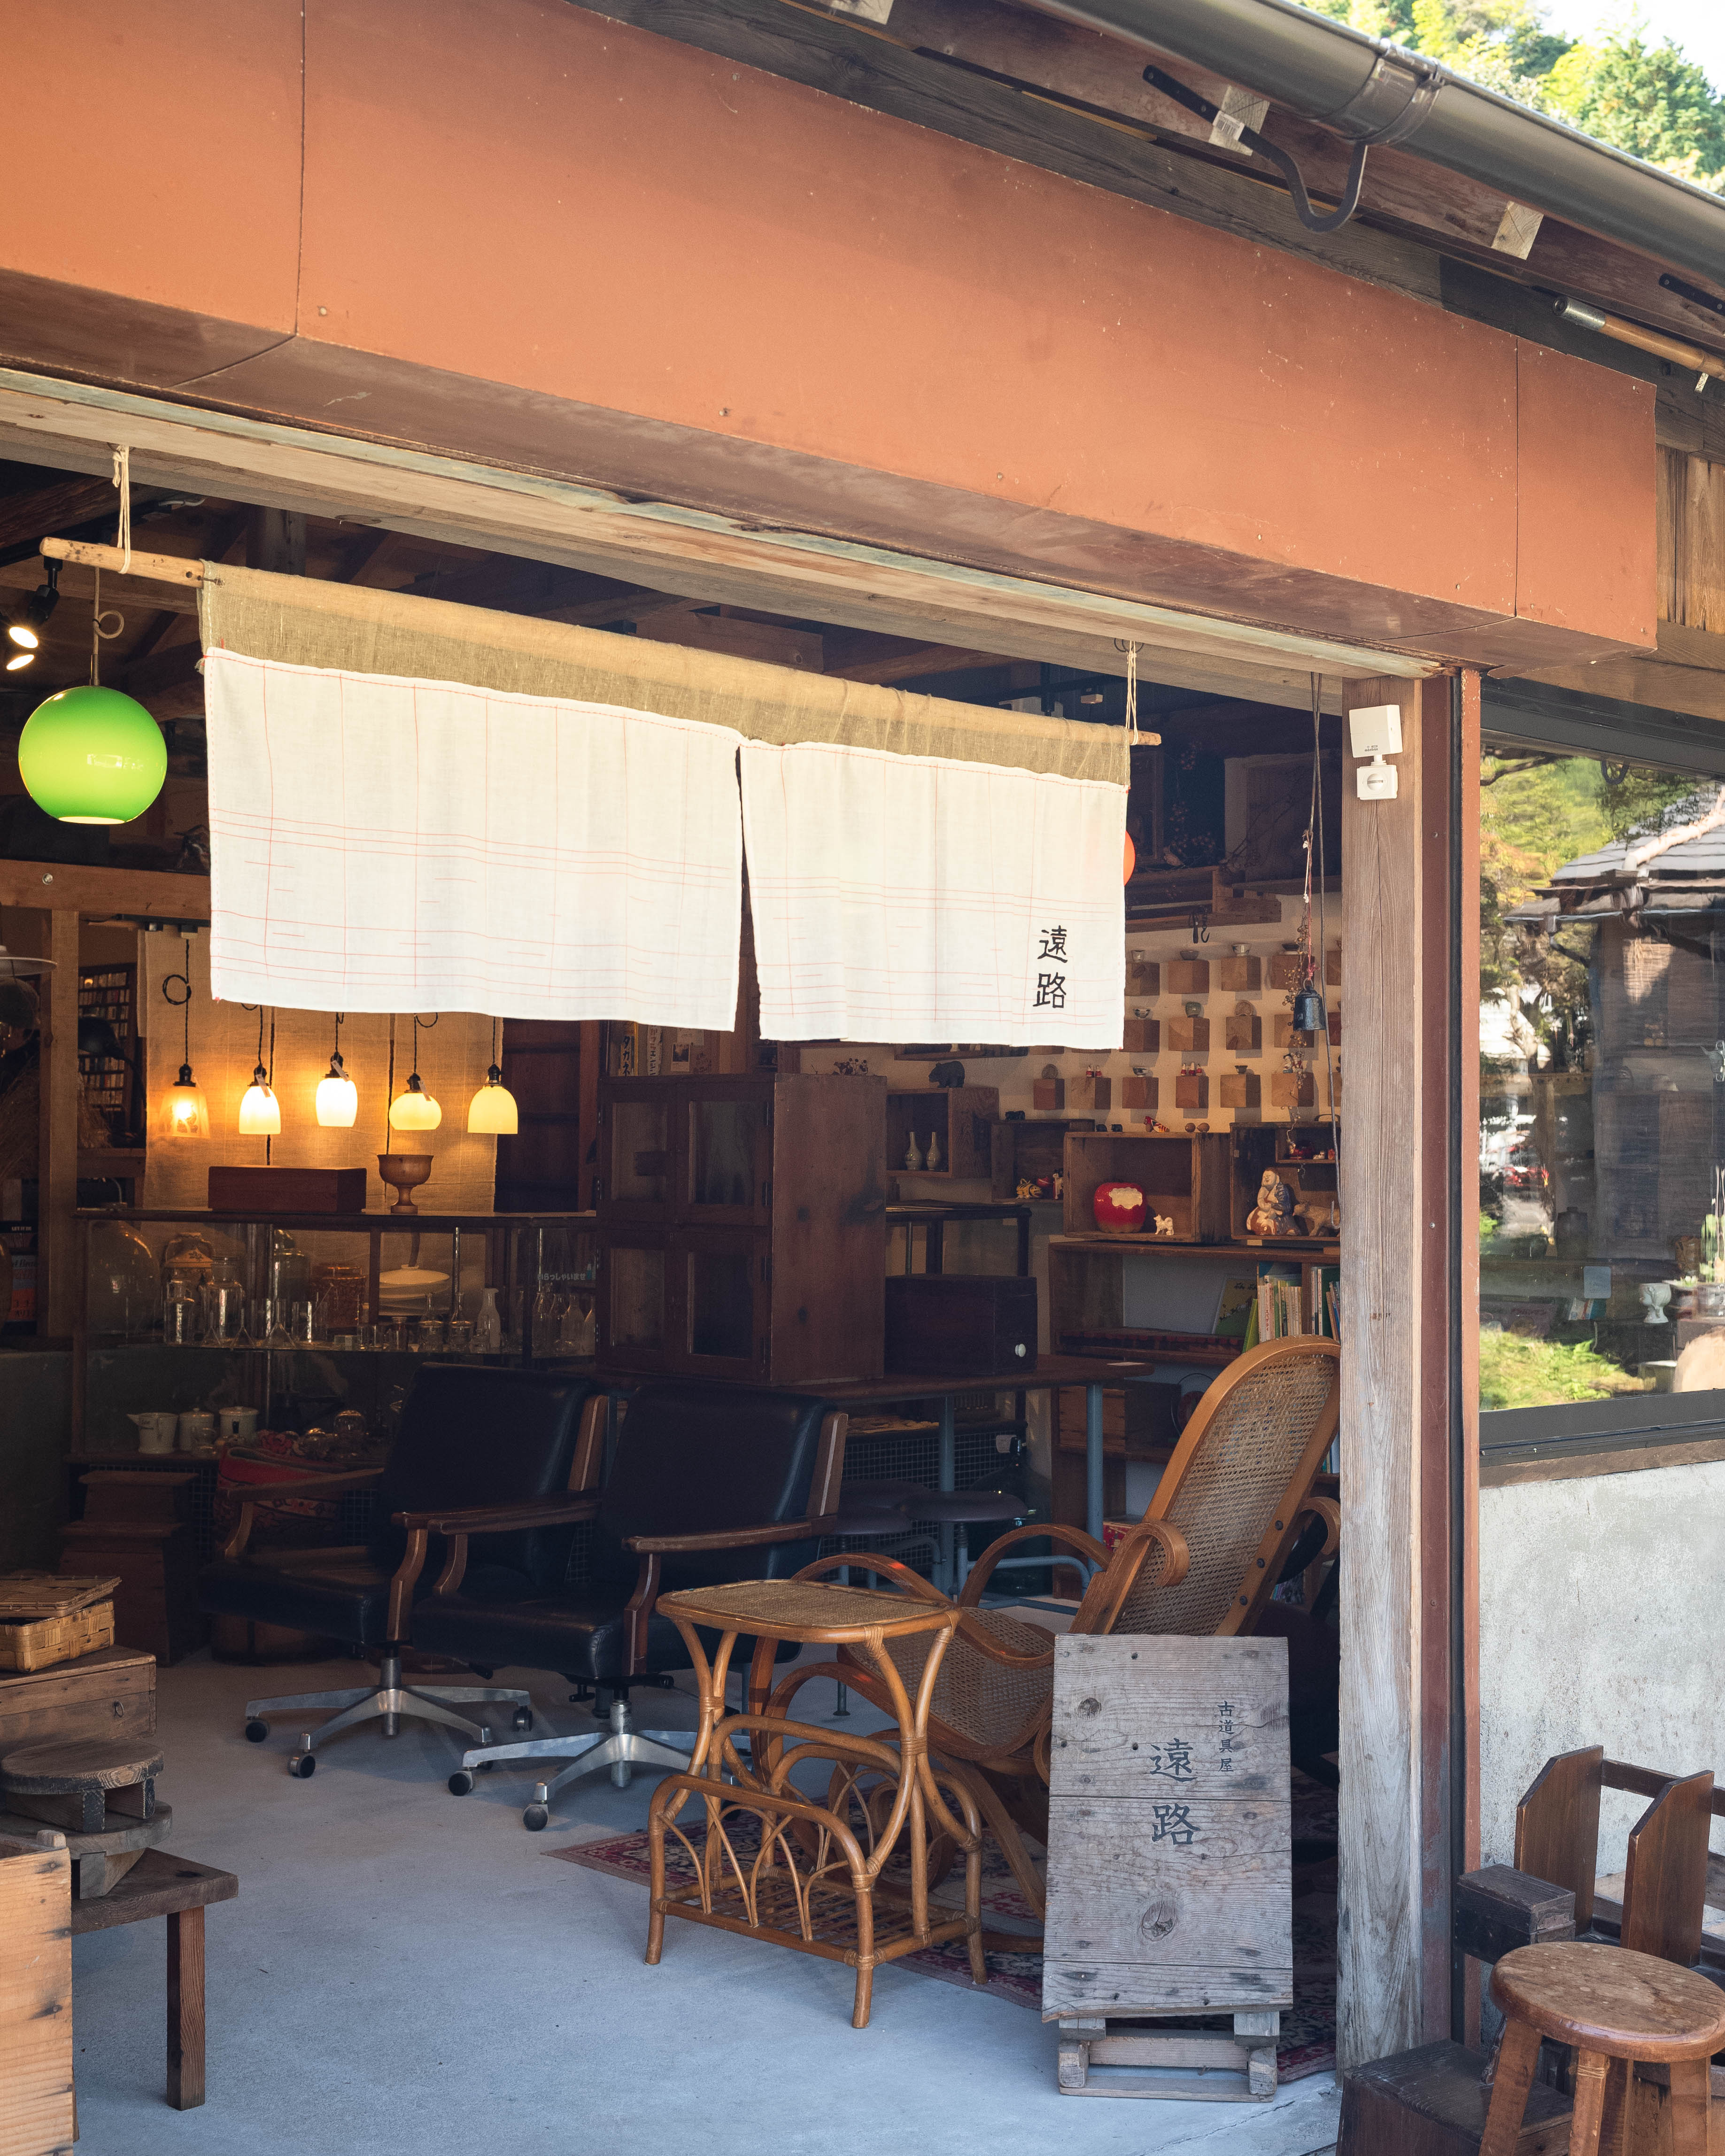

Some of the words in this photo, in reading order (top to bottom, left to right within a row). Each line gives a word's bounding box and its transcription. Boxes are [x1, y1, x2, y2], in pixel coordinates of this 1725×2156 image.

[1033, 925, 1067, 1008] 遠路
[537, 1273, 587, 1281] いらっしゃいませ
[1217, 1700, 1235, 1772] 古道具屋
[1150, 1738, 1201, 1845] 遠路
